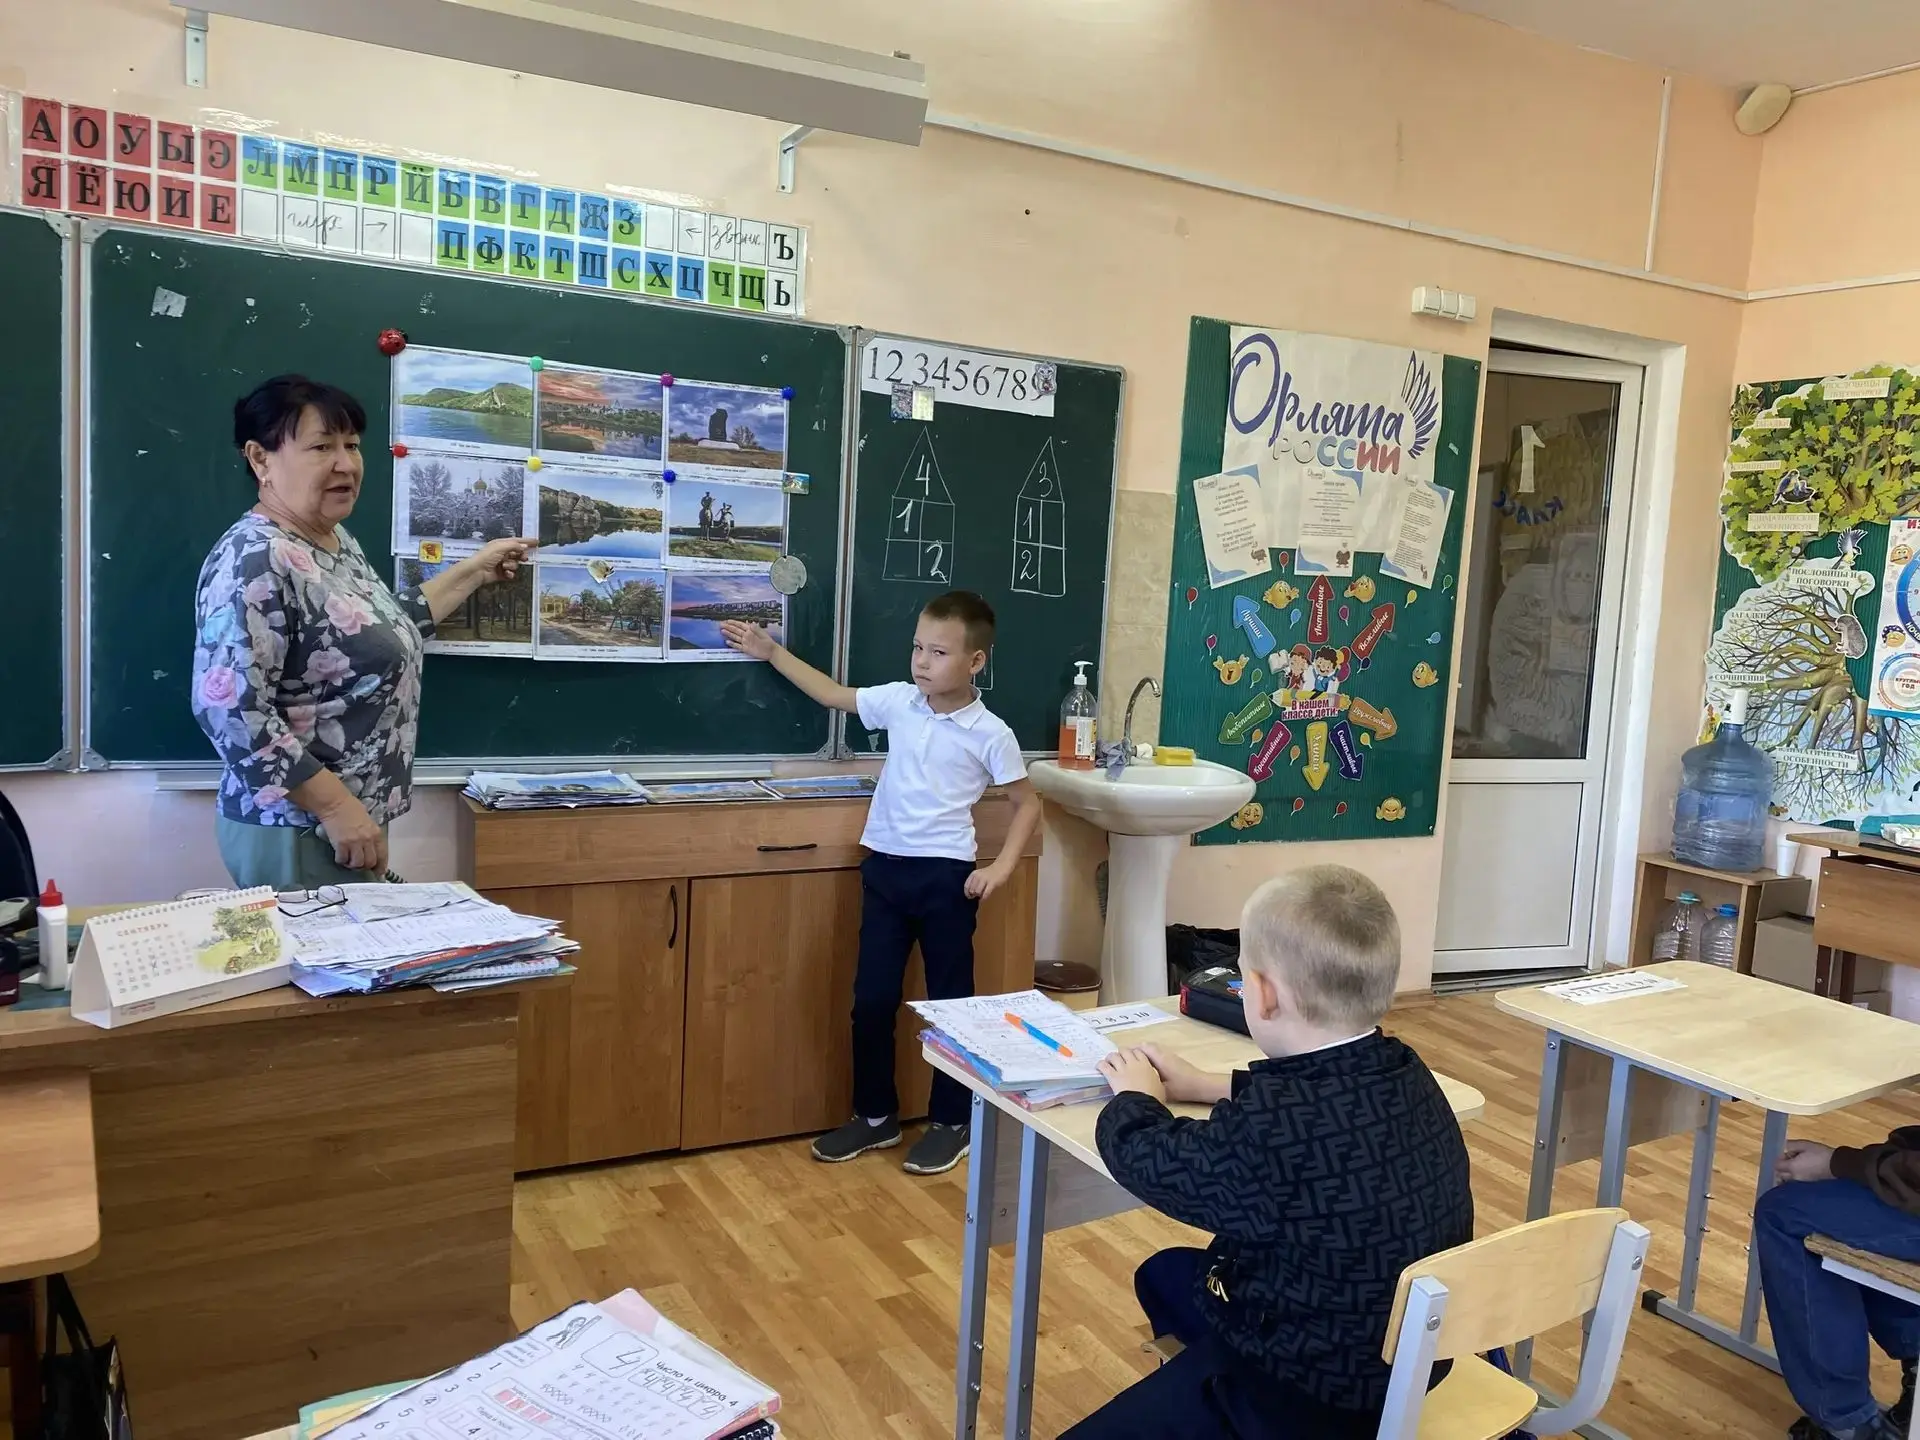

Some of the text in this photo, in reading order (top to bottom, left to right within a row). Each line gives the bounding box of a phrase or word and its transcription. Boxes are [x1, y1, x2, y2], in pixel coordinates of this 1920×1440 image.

[28, 110, 635, 236] А О У Ы Э Л М Н Р Й Б В Г Д Ж З
[27, 165, 231, 225] Я Ё Ю И Е
[773, 232, 794, 260] Ъ
[442, 229, 791, 311] П Ф К Т Ш С Х Ц Ч Щ Ь
[1229, 333, 1405, 448] Орлята
[915, 454, 930, 496] 4
[1038, 461, 1053, 498] 3
[896, 499, 914, 534] 1
[1022, 507, 1033, 540] 1
[926, 540, 949, 583] 2
[1020, 549, 1036, 580] 2
[1791, 567, 1857, 579] ПОСЛОВИЦЫ И
[1796, 577, 1850, 587] ПОГОВОРКИ
[1241, 608, 1264, 641] Лучшие
[1315, 584, 1326, 638] Активные
[1357, 610, 1390, 652] Вежливые
[1714, 674, 1765, 683] СОЧИНЕНИЯ
[1281, 709, 1314, 720] классе
[1291, 699, 1330, 711] В нашем
[1252, 730, 1284, 775] Креативные
[1337, 729, 1359, 775] Счастливые
[1783, 755, 1849, 768] ОСОБЕННОСТИ
[117, 922, 169, 938] СЕНТЯБРЬ
[467, 1373, 482, 1382] 2
[489, 1362, 503, 1371] 1
[424, 1394, 438, 1406] 4
[444, 1384, 459, 1393] 3
[656, 1361, 740, 1408] Число и цифра 4
[374, 1421, 390, 1430] 6
[398, 1407, 415, 1418] 5
[467, 1427, 482, 1436] 4
